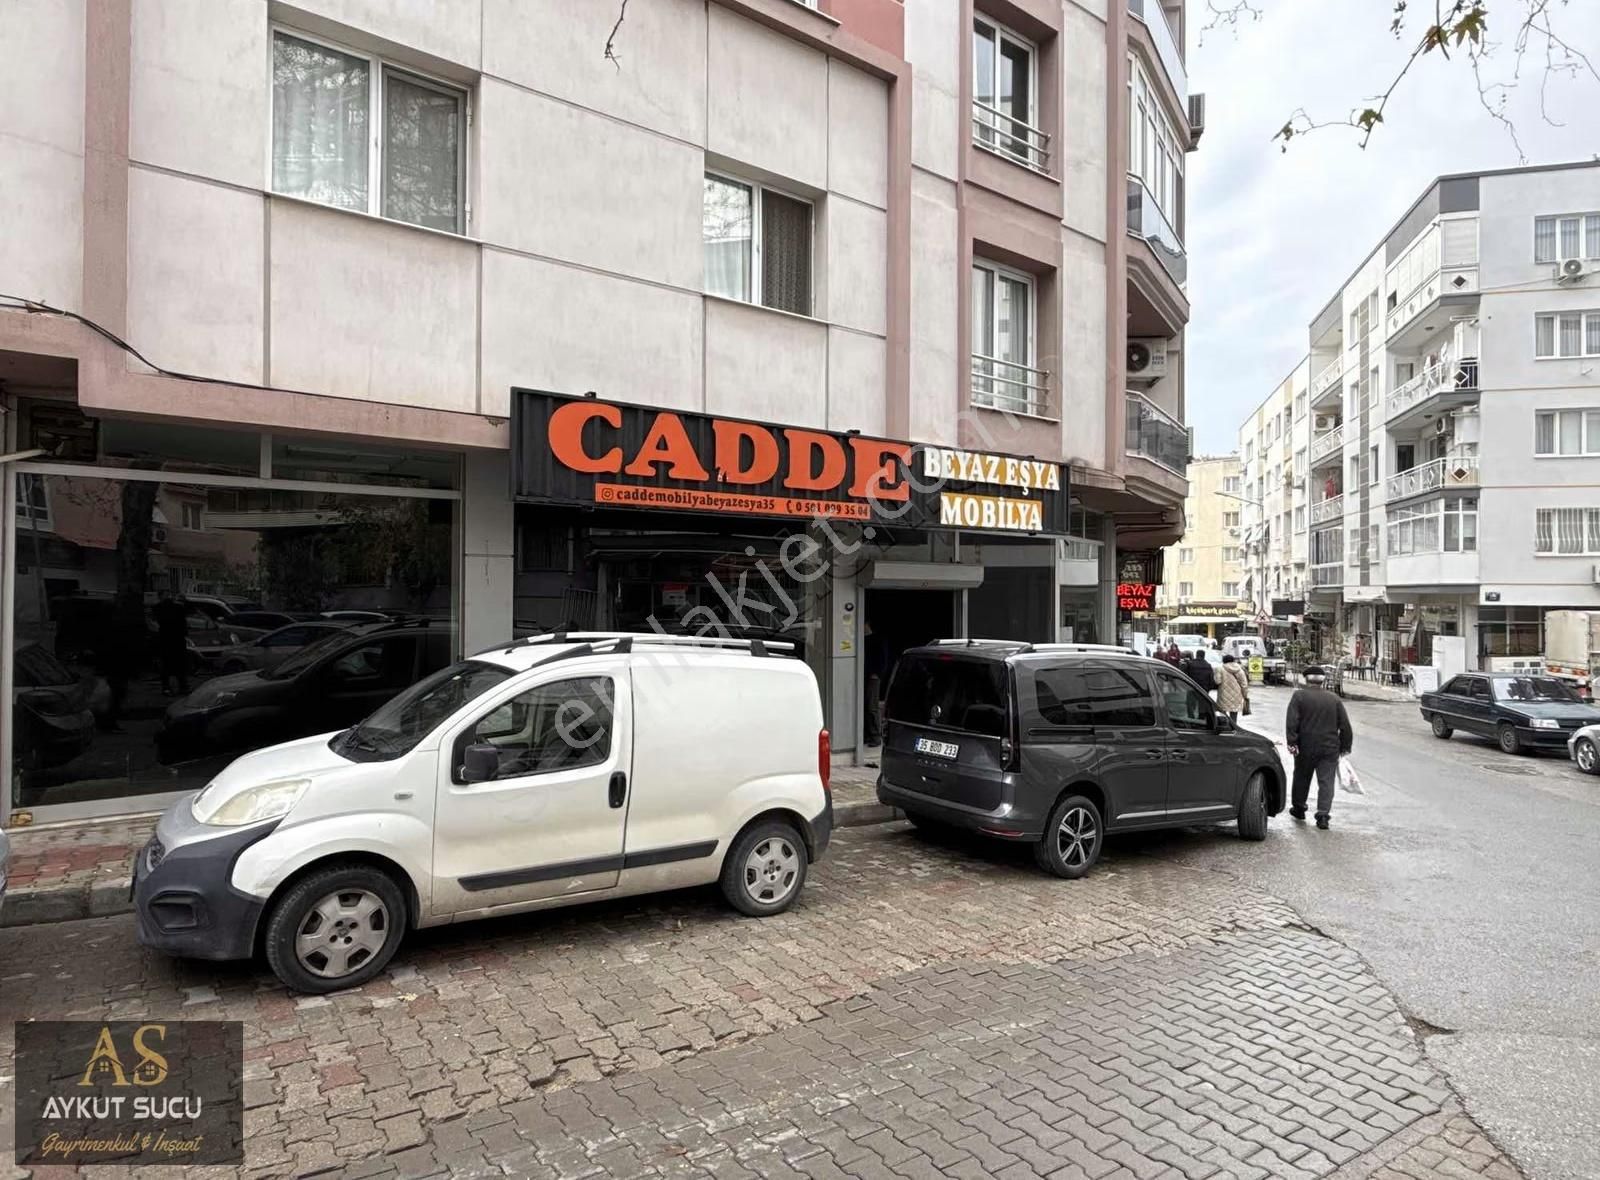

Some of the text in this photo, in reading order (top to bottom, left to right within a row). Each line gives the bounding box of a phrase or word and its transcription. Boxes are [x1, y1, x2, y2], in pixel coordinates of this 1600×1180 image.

[548, 401, 912, 501] CADDE
[924, 447, 1060, 495] BEYAZ EŞYA
[616, 488, 775, 511] caddemobilyabeyazesya35
[845, 504, 855, 515] 35
[940, 494, 1043, 530] MOBİLYA
[1117, 584, 1152, 596] BEYAZ
[1120, 598, 1149, 610] EŞYA
[944, 745, 957, 756] 233
